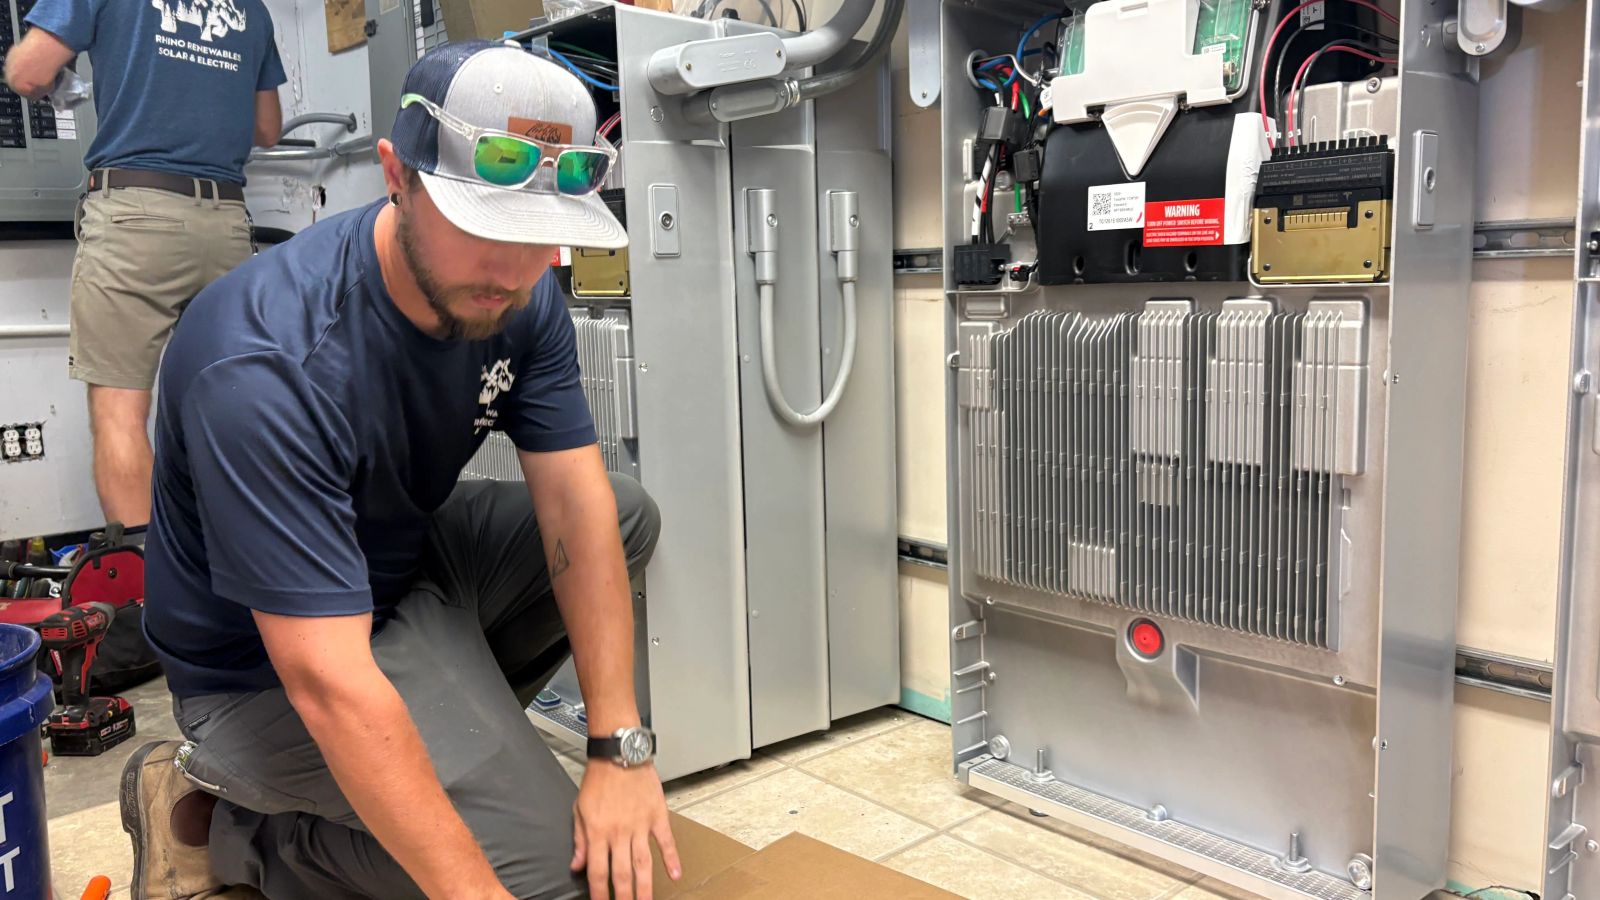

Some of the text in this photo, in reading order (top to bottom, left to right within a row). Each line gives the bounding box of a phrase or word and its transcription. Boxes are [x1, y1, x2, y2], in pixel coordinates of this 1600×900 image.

[155, 34, 242, 62] RHINO RENEWABLES
[158, 46, 239, 72] SOLAR & ELECTRIC
[1164, 204, 1201, 218] WARNING
[1089, 222, 1094, 230] 2
